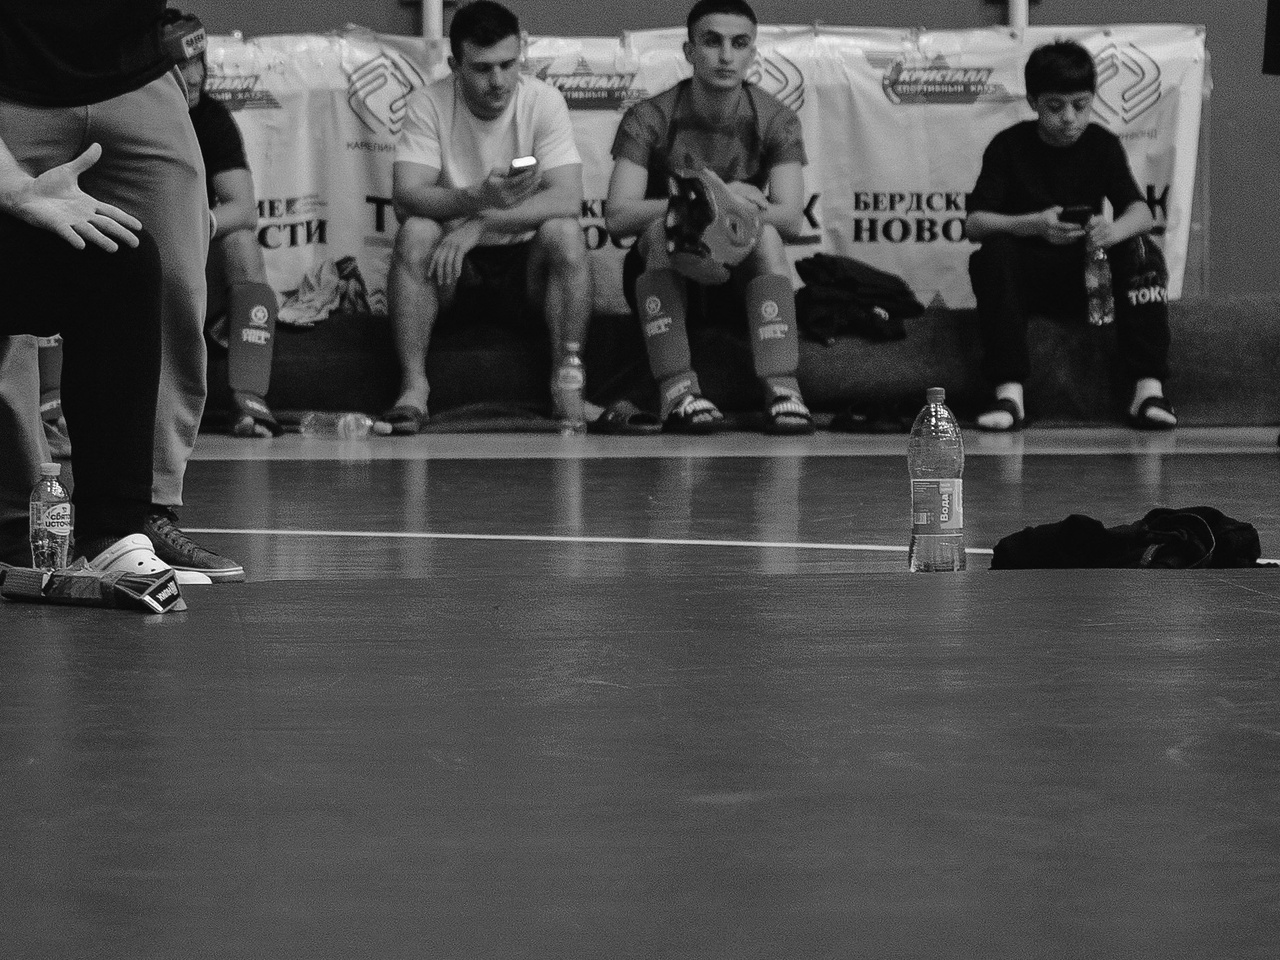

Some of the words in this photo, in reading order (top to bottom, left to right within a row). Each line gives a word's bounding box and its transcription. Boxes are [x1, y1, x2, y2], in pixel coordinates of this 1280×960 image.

[854, 192, 969, 215] БЕРДСК
[853, 217, 969, 243] НОВО
[1128, 285, 1168, 306] TOKY
[940, 493, 949, 521] Вода
